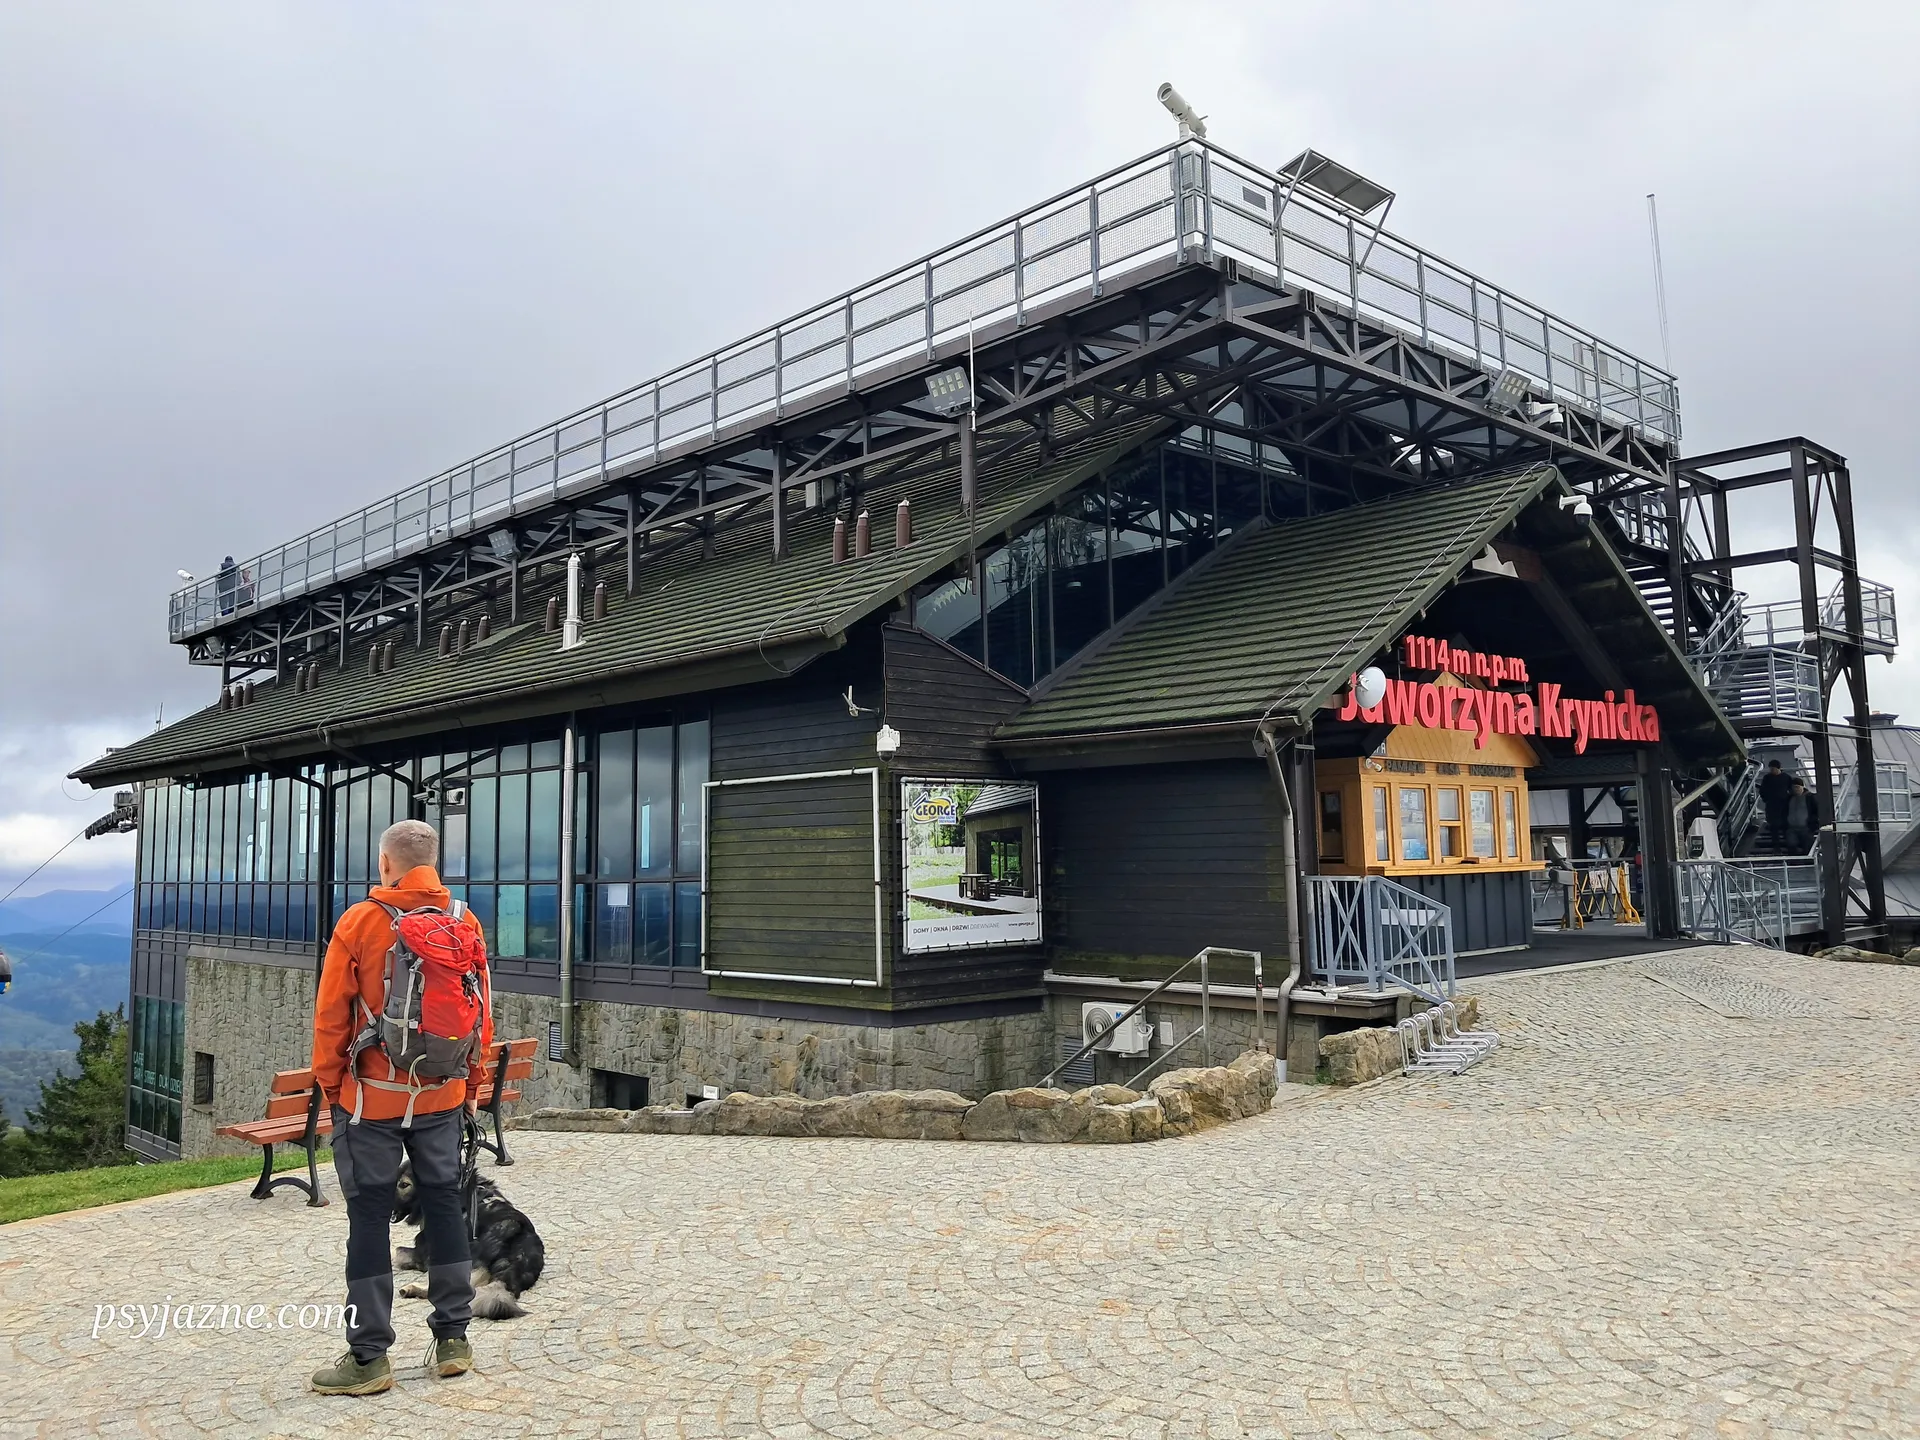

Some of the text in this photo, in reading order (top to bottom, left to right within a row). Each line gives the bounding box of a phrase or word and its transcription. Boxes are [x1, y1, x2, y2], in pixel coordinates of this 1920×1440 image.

[1404, 634, 1450, 672] 1114
[1450, 648, 1471, 675] m
[1538, 682, 1660, 755] Krynicka
[916, 805, 956, 816] GEORGE
